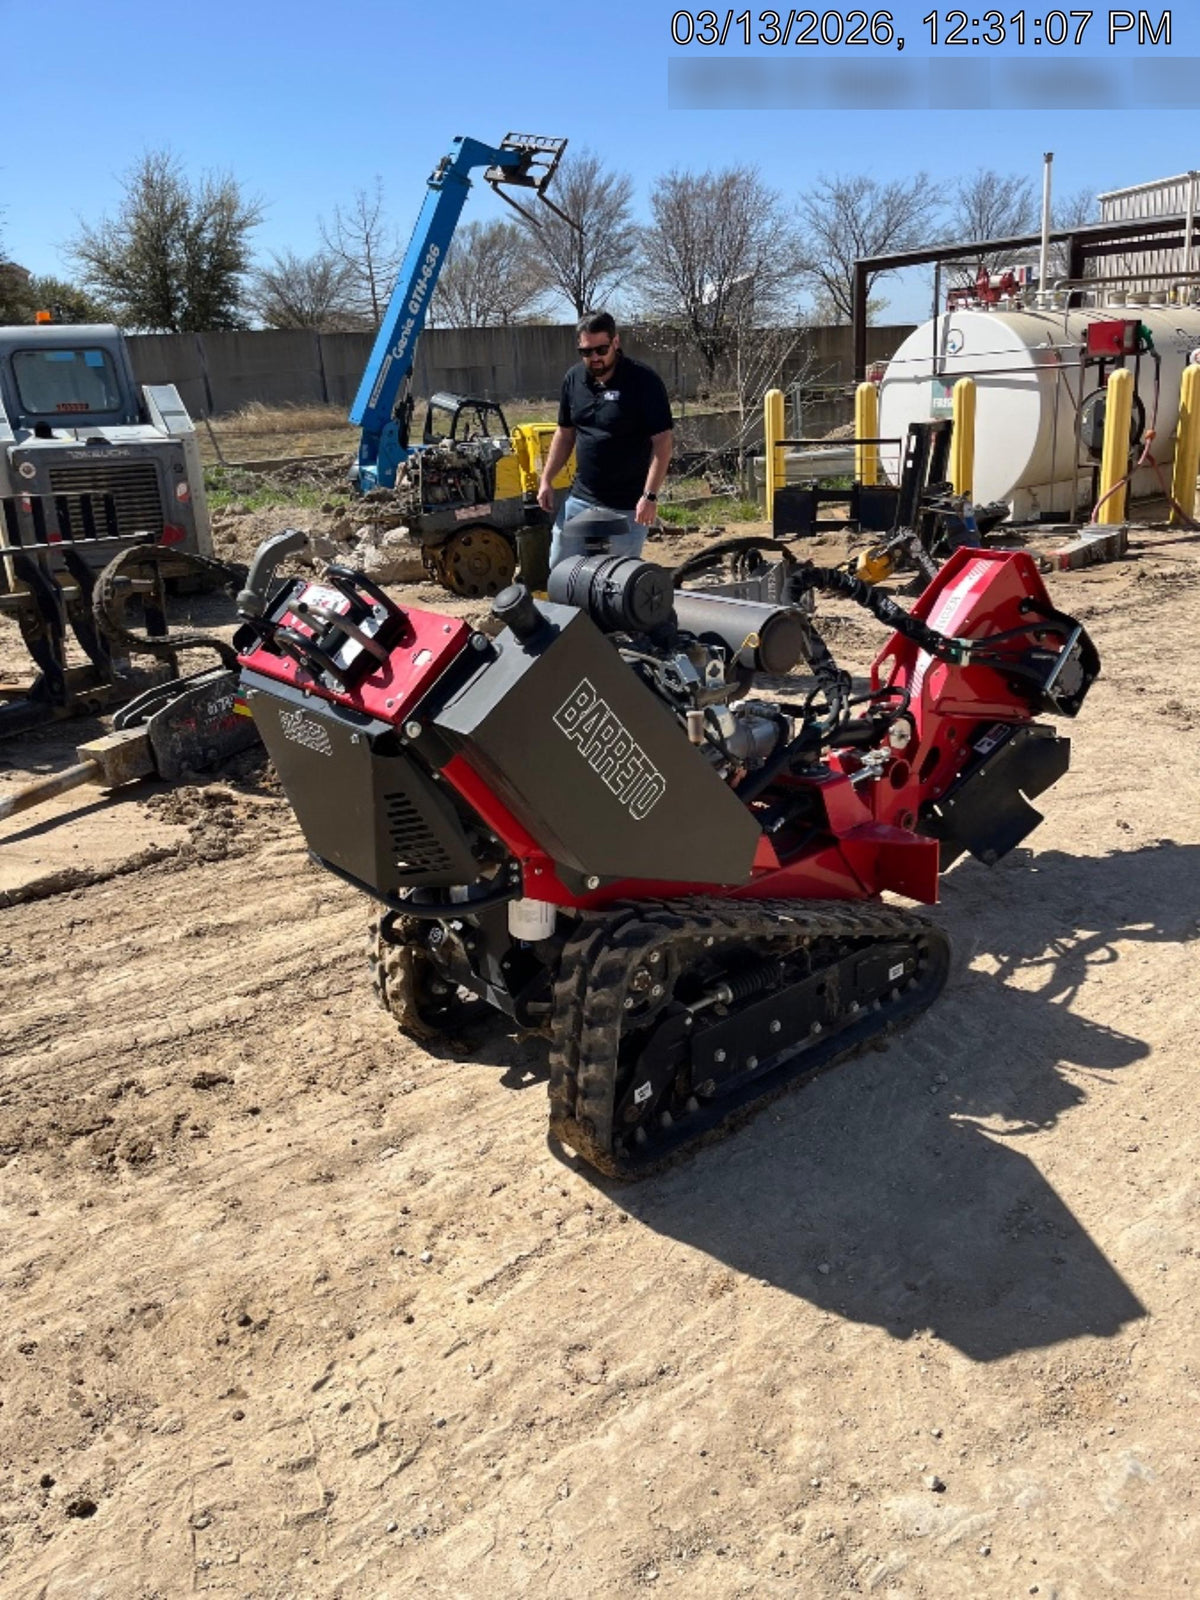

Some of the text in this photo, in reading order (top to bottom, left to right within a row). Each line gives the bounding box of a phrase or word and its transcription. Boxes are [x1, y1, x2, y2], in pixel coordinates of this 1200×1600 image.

[392, 243, 440, 359] Genie GTH-636
[552, 677, 667, 821] BARRETO
